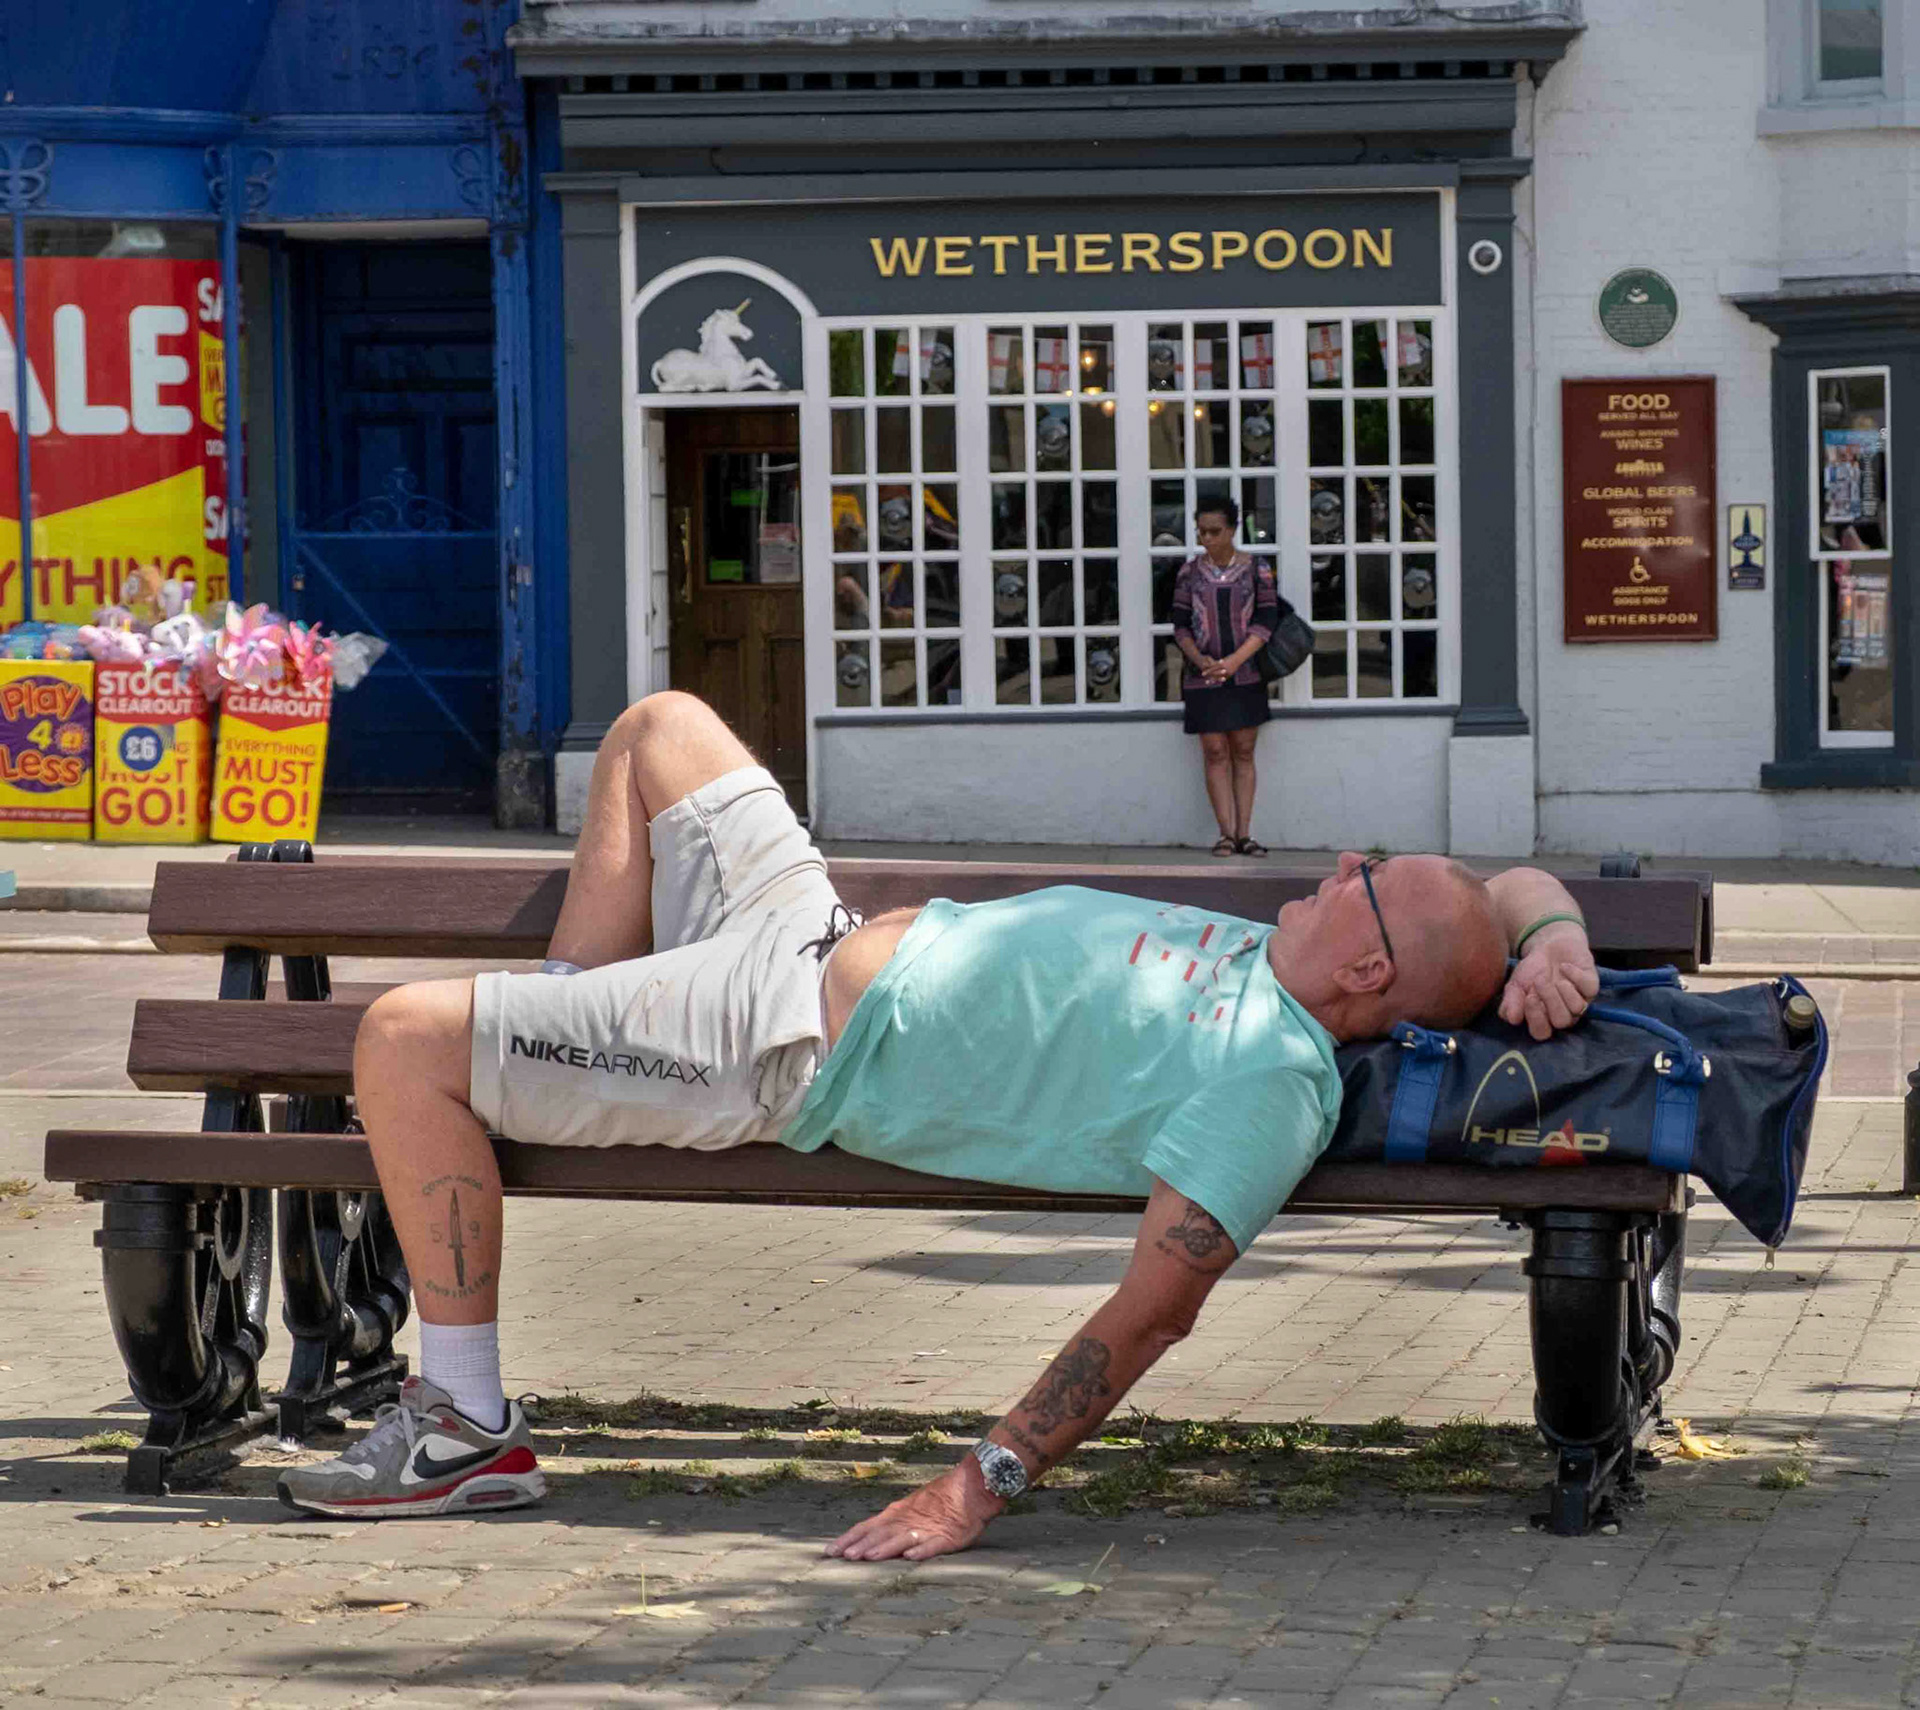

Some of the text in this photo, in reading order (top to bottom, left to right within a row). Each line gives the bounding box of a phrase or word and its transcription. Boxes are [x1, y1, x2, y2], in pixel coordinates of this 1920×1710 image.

[870, 228, 1393, 277] WETHERSPOON
[1608, 394, 1670, 410] FOOD
[1615, 438, 1664, 450] WINES
[1583, 486, 1697, 499] GLOBAL BEERS
[1582, 536, 1694, 549] ACCOMMODATION
[1585, 613, 1698, 625] WETHERSPOON
[98, 670, 192, 696] STOCK
[0, 680, 81, 721] Play
[98, 697, 193, 714] CLEAROUT
[227, 695, 323, 717] CLEAROUT
[27, 720, 53, 750] 4
[225, 738, 316, 755] EVERYTHING
[0, 743, 84, 786] Less
[224, 756, 315, 786] MUST
[101, 787, 186, 827] GO!
[221, 786, 309, 829] GO!
[1471, 1125, 1610, 1151] HEAD
